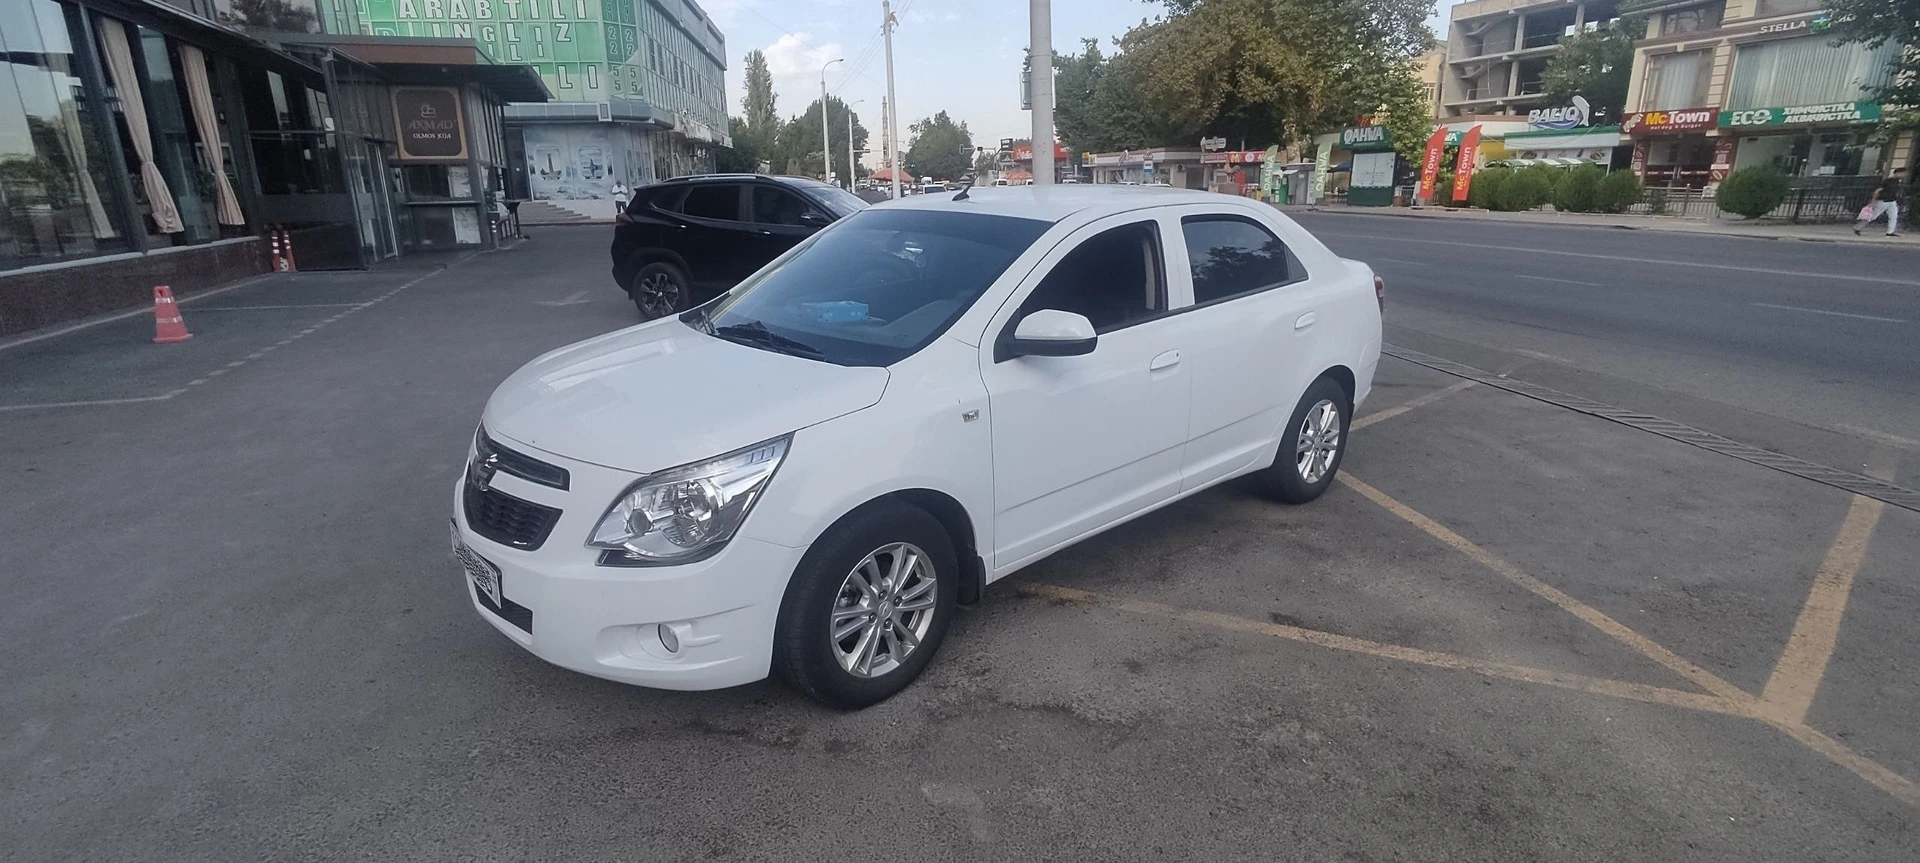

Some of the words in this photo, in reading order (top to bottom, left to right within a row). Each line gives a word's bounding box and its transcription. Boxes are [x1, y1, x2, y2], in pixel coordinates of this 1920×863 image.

[399, 0, 493, 20] ARAB
[504, 0, 587, 20] TILI
[1760, 20, 1807, 34] STELLA
[1782, 102, 1855, 116] ХИМЧИСТКА
[1645, 111, 1710, 126] McTown
[1730, 109, 1772, 126] ECO
[1783, 110, 1861, 124] АКВАЧИСТКА
[1344, 127, 1385, 145] QAHWA
